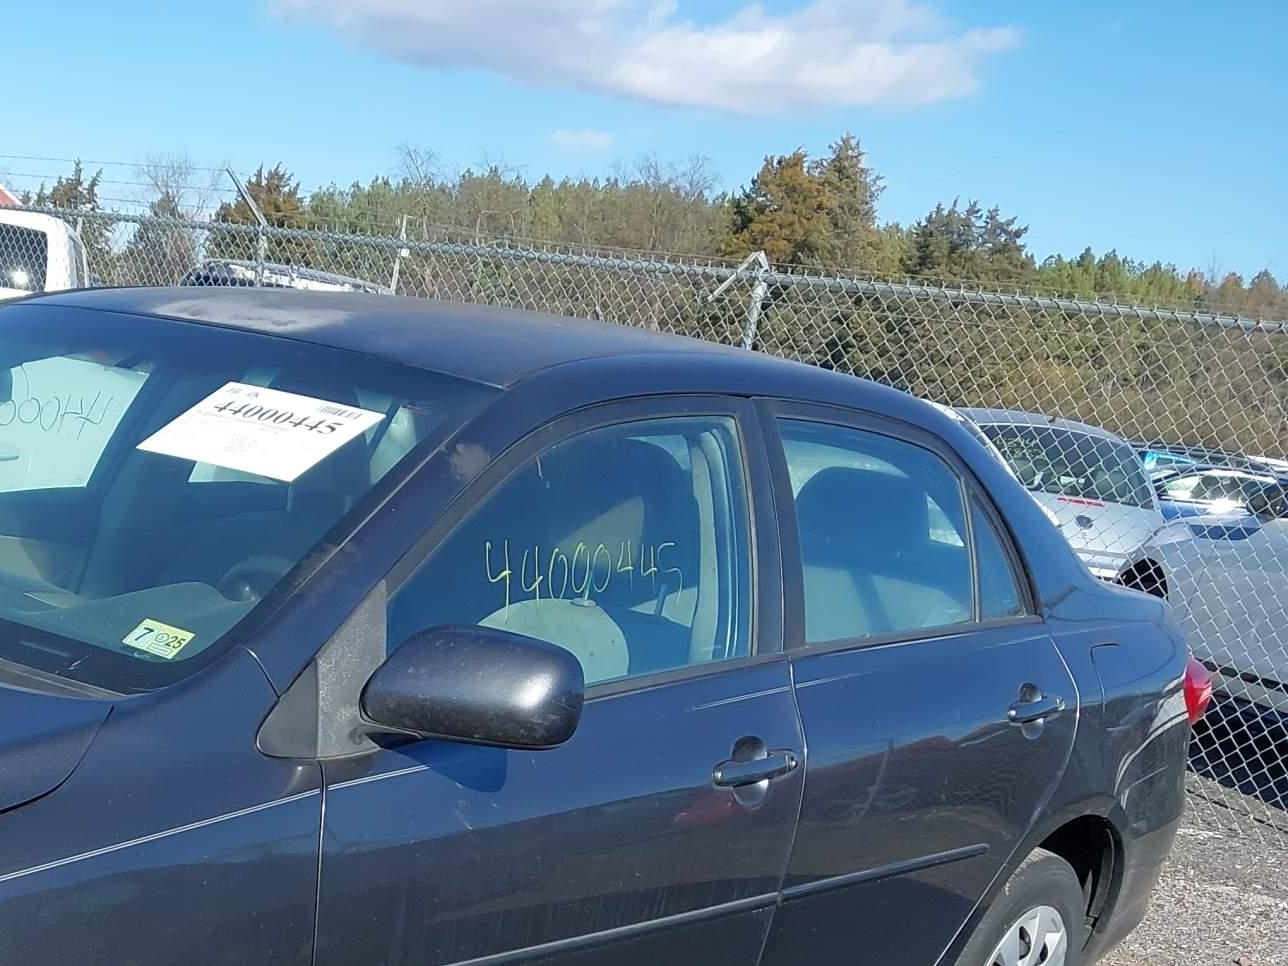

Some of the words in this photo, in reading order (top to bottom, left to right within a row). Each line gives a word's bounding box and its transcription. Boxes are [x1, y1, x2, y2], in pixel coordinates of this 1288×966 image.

[213, 400, 345, 435] 44000445
[485, 539, 683, 624] 44000445
[135, 627, 155, 641] 7
[166, 636, 187, 649] 25
